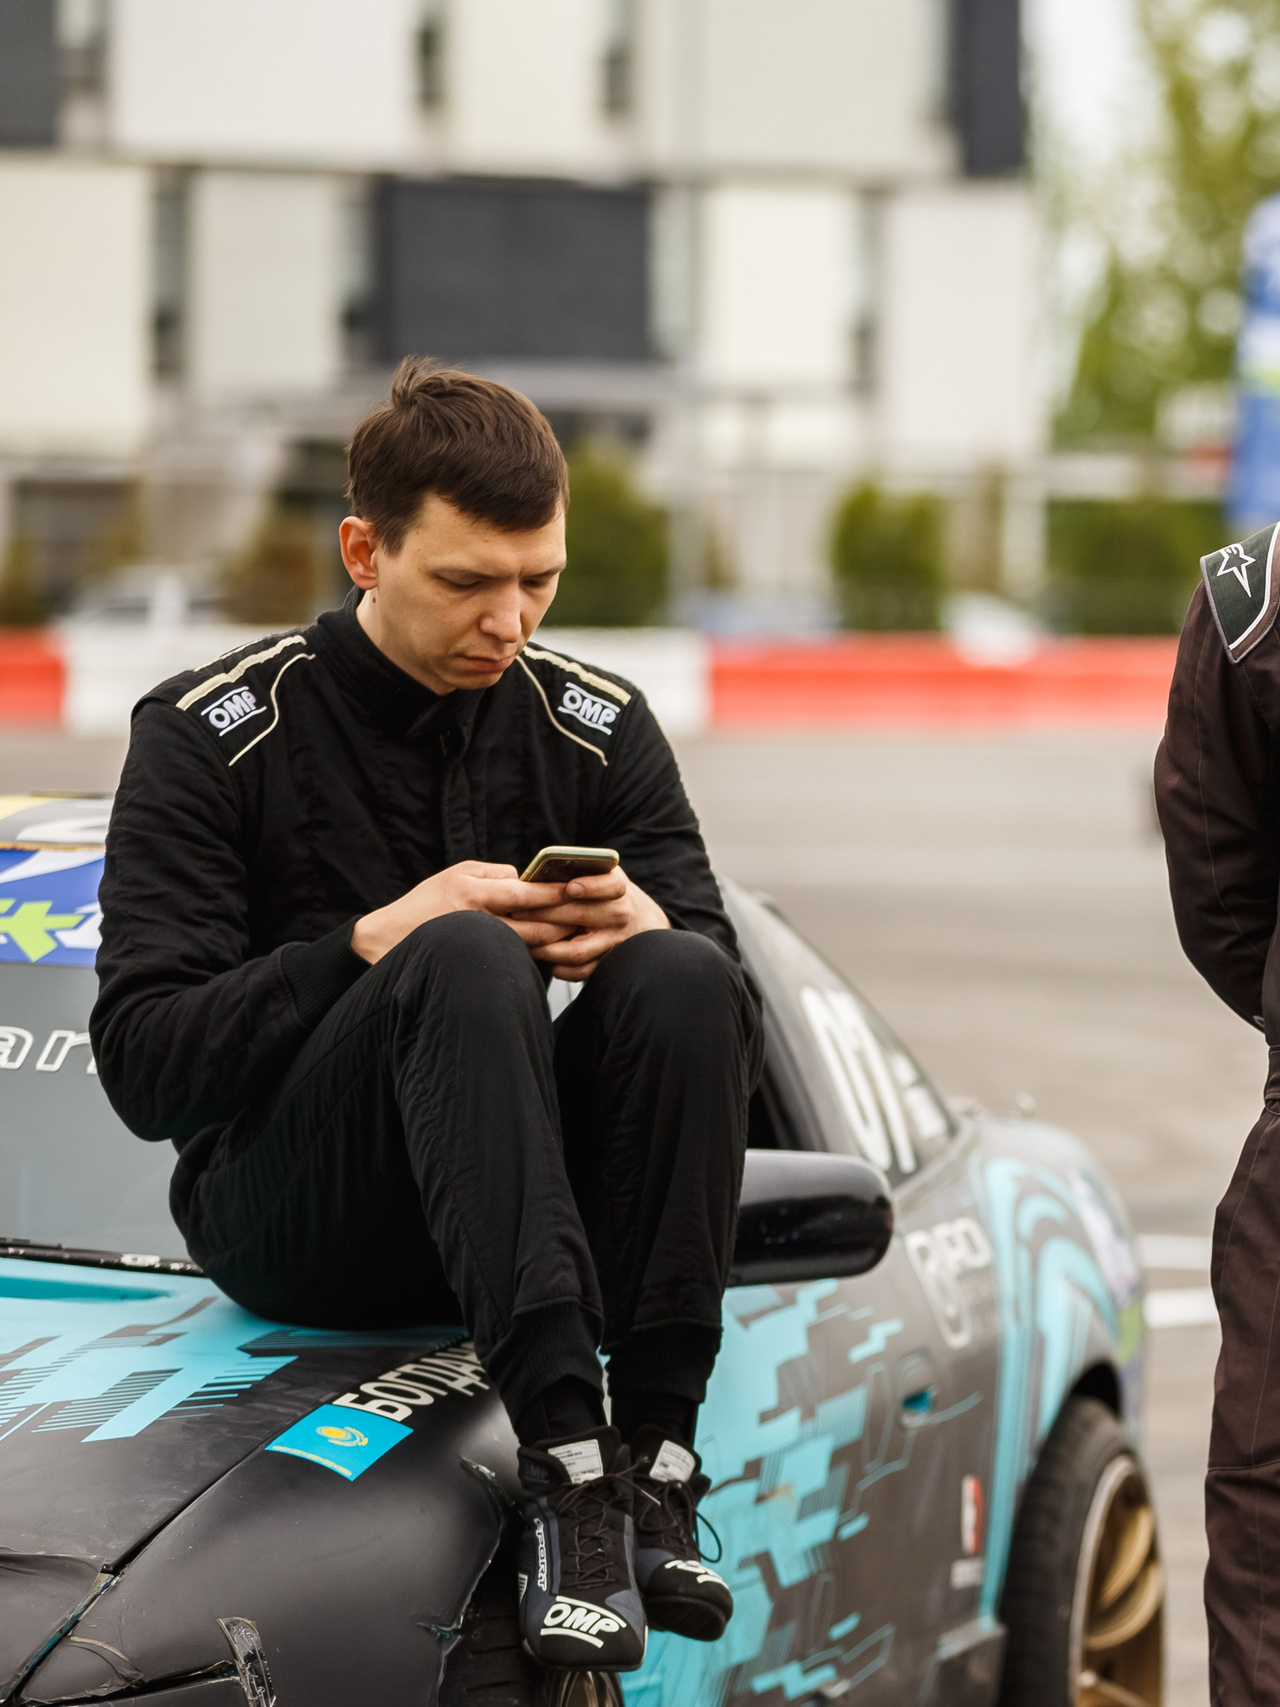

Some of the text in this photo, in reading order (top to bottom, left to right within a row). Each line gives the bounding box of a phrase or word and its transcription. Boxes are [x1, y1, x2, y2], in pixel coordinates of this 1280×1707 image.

[208, 690, 257, 729] OMP
[562, 689, 617, 727] OMP
[543, 1603, 620, 1635] OMP
